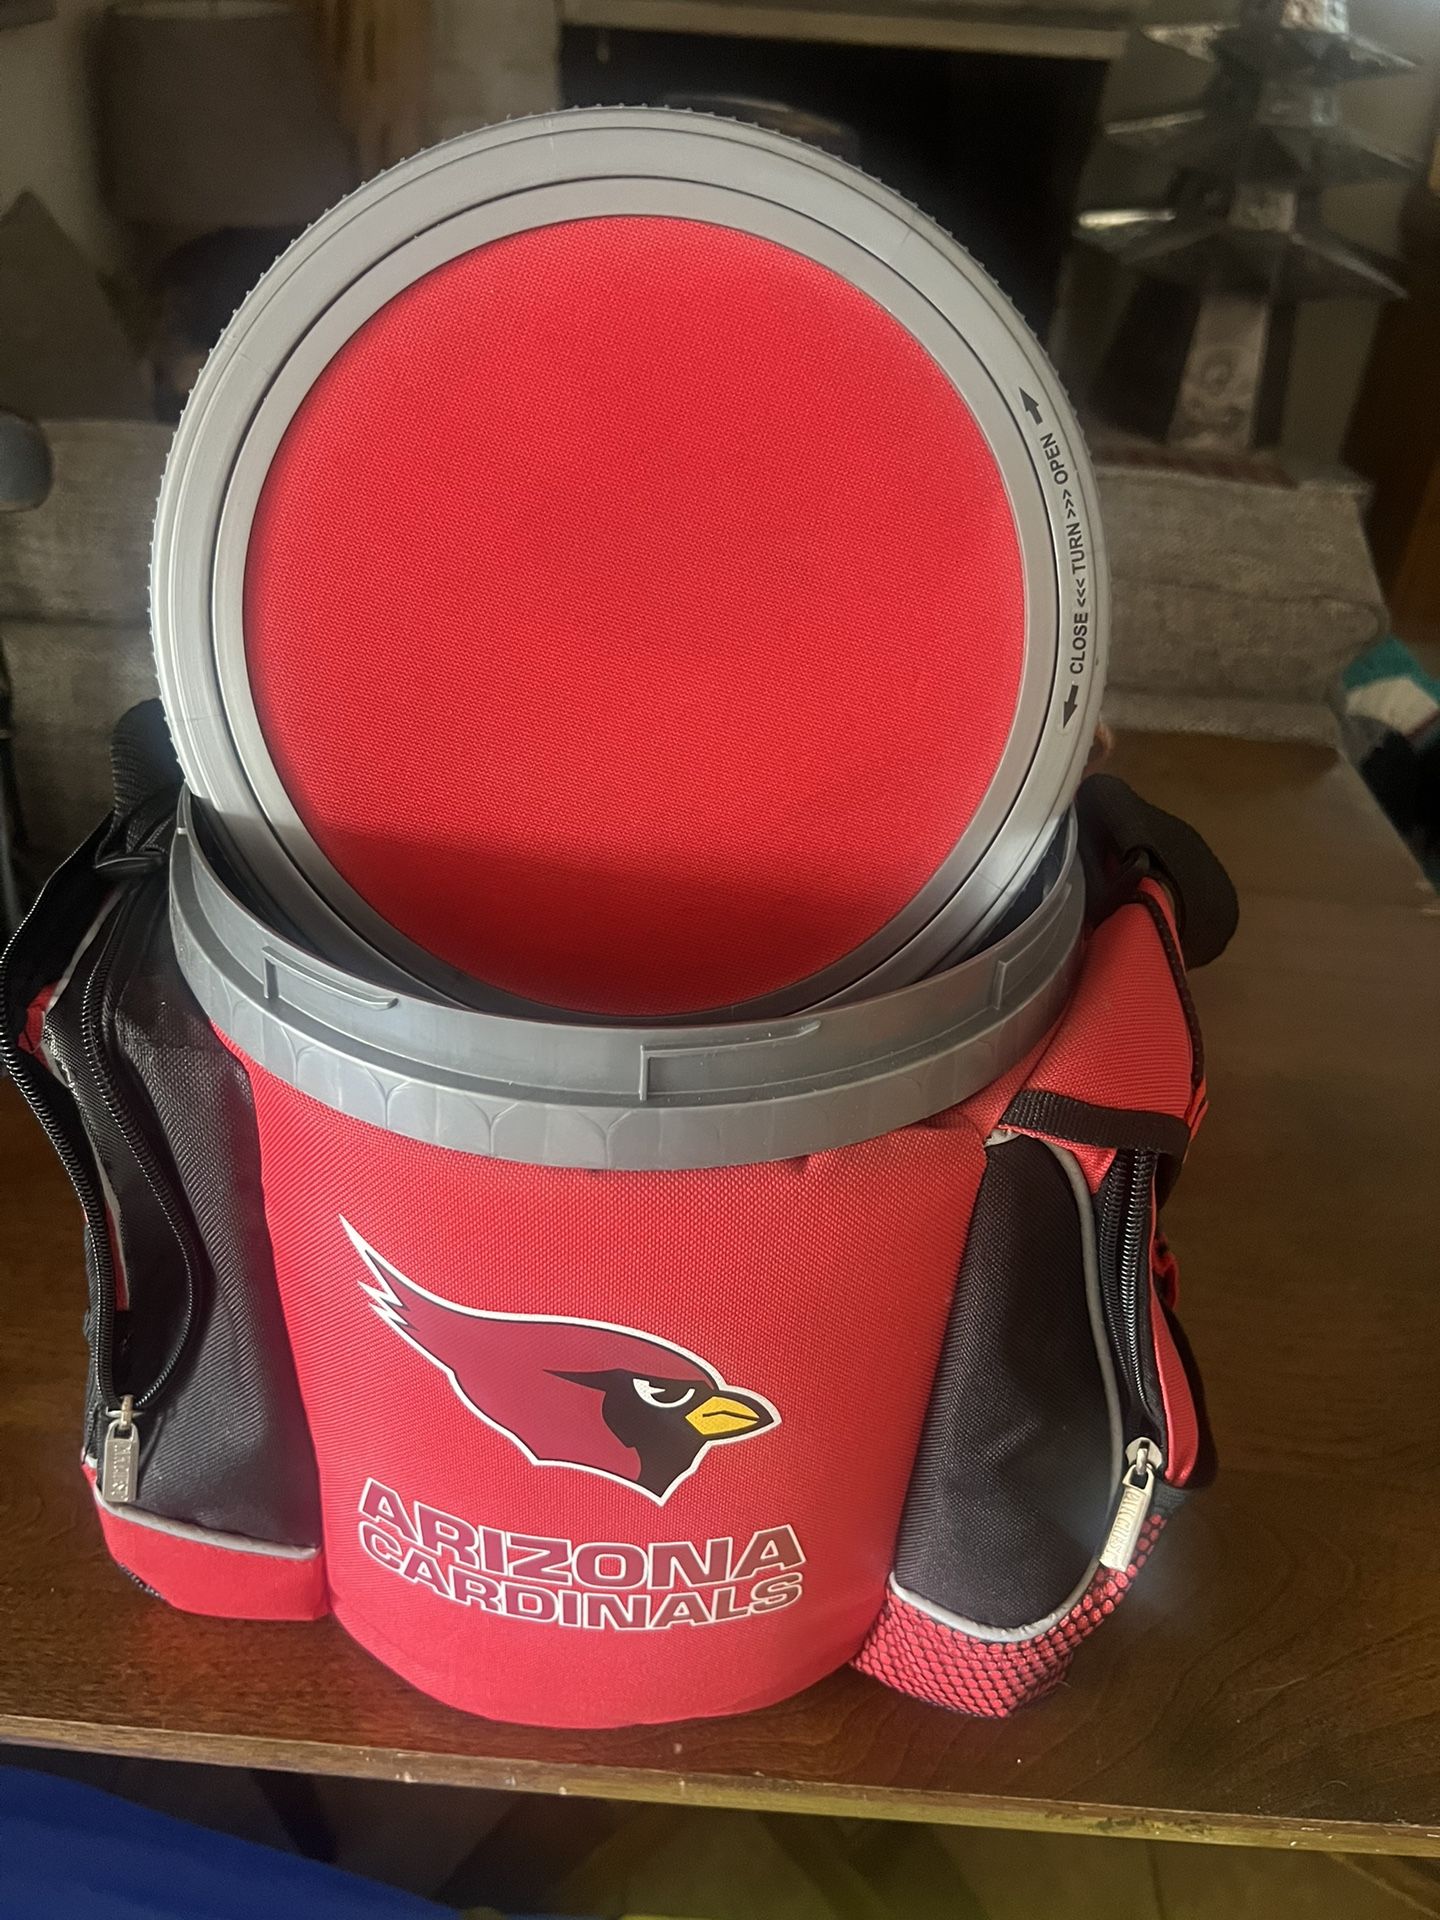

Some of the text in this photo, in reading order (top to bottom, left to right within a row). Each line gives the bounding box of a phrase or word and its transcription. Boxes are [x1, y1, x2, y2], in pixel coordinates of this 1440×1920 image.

[1040, 432, 1069, 485] OPEN
[1066, 522, 1087, 575] TURN
[1070, 612, 1088, 674] CLOSE
[358, 1477, 807, 1590] ARIZONA
[358, 1520, 803, 1632] CARDINALS
